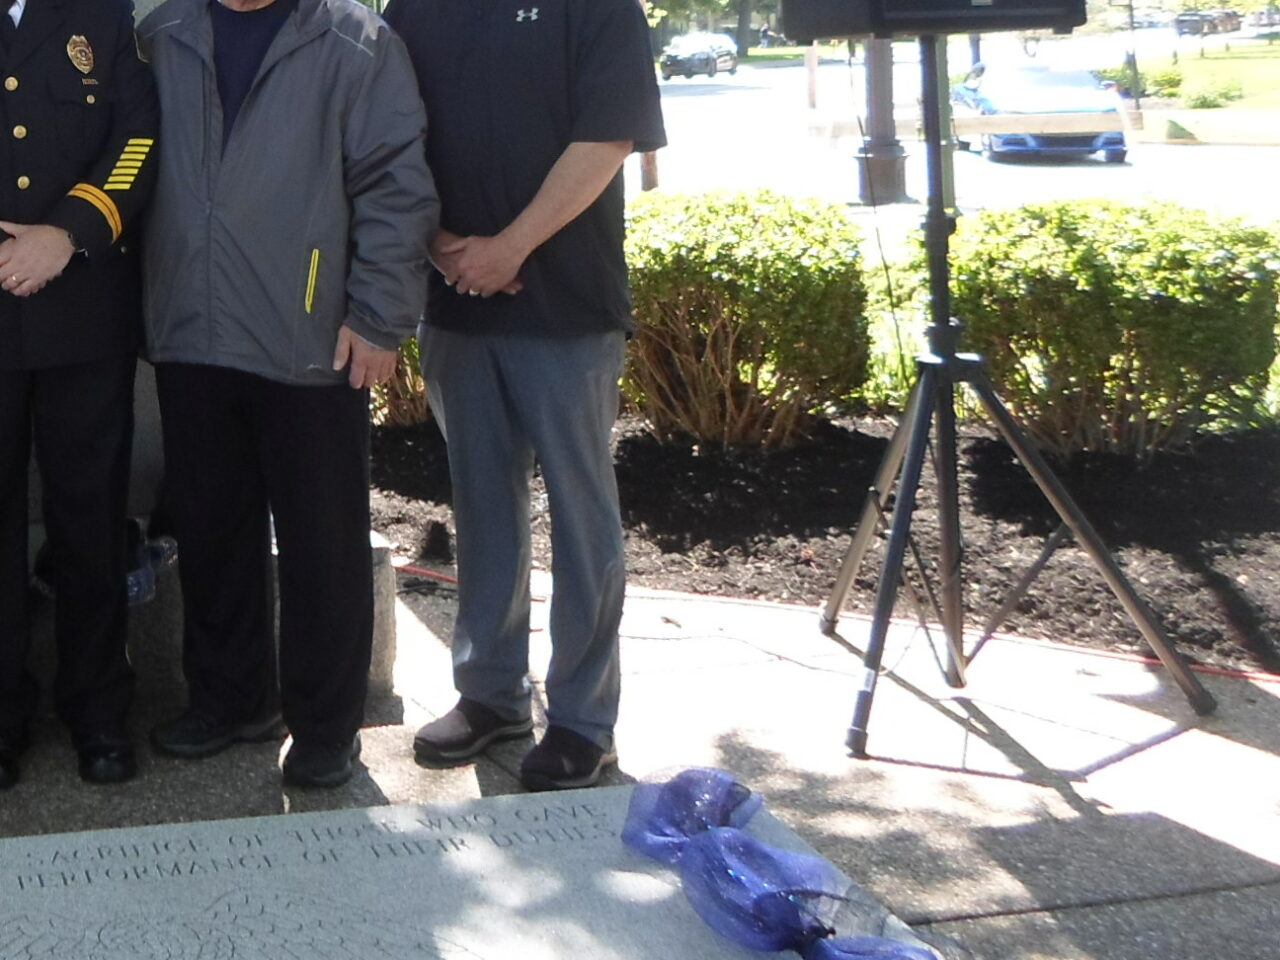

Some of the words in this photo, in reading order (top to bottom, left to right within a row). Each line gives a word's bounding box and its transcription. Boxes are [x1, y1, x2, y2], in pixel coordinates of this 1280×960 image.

[18, 853, 287, 890] PERFORMANCE
[303, 847, 340, 865] OF
[370, 836, 471, 860] THEIR
[489, 823, 617, 849] DUTIES
[25, 837, 210, 867] SACRIFICE
[228, 833, 265, 849] OF
[286, 817, 401, 844] THOSE
[415, 812, 497, 832] WHO
[514, 803, 607, 822] GAVE
